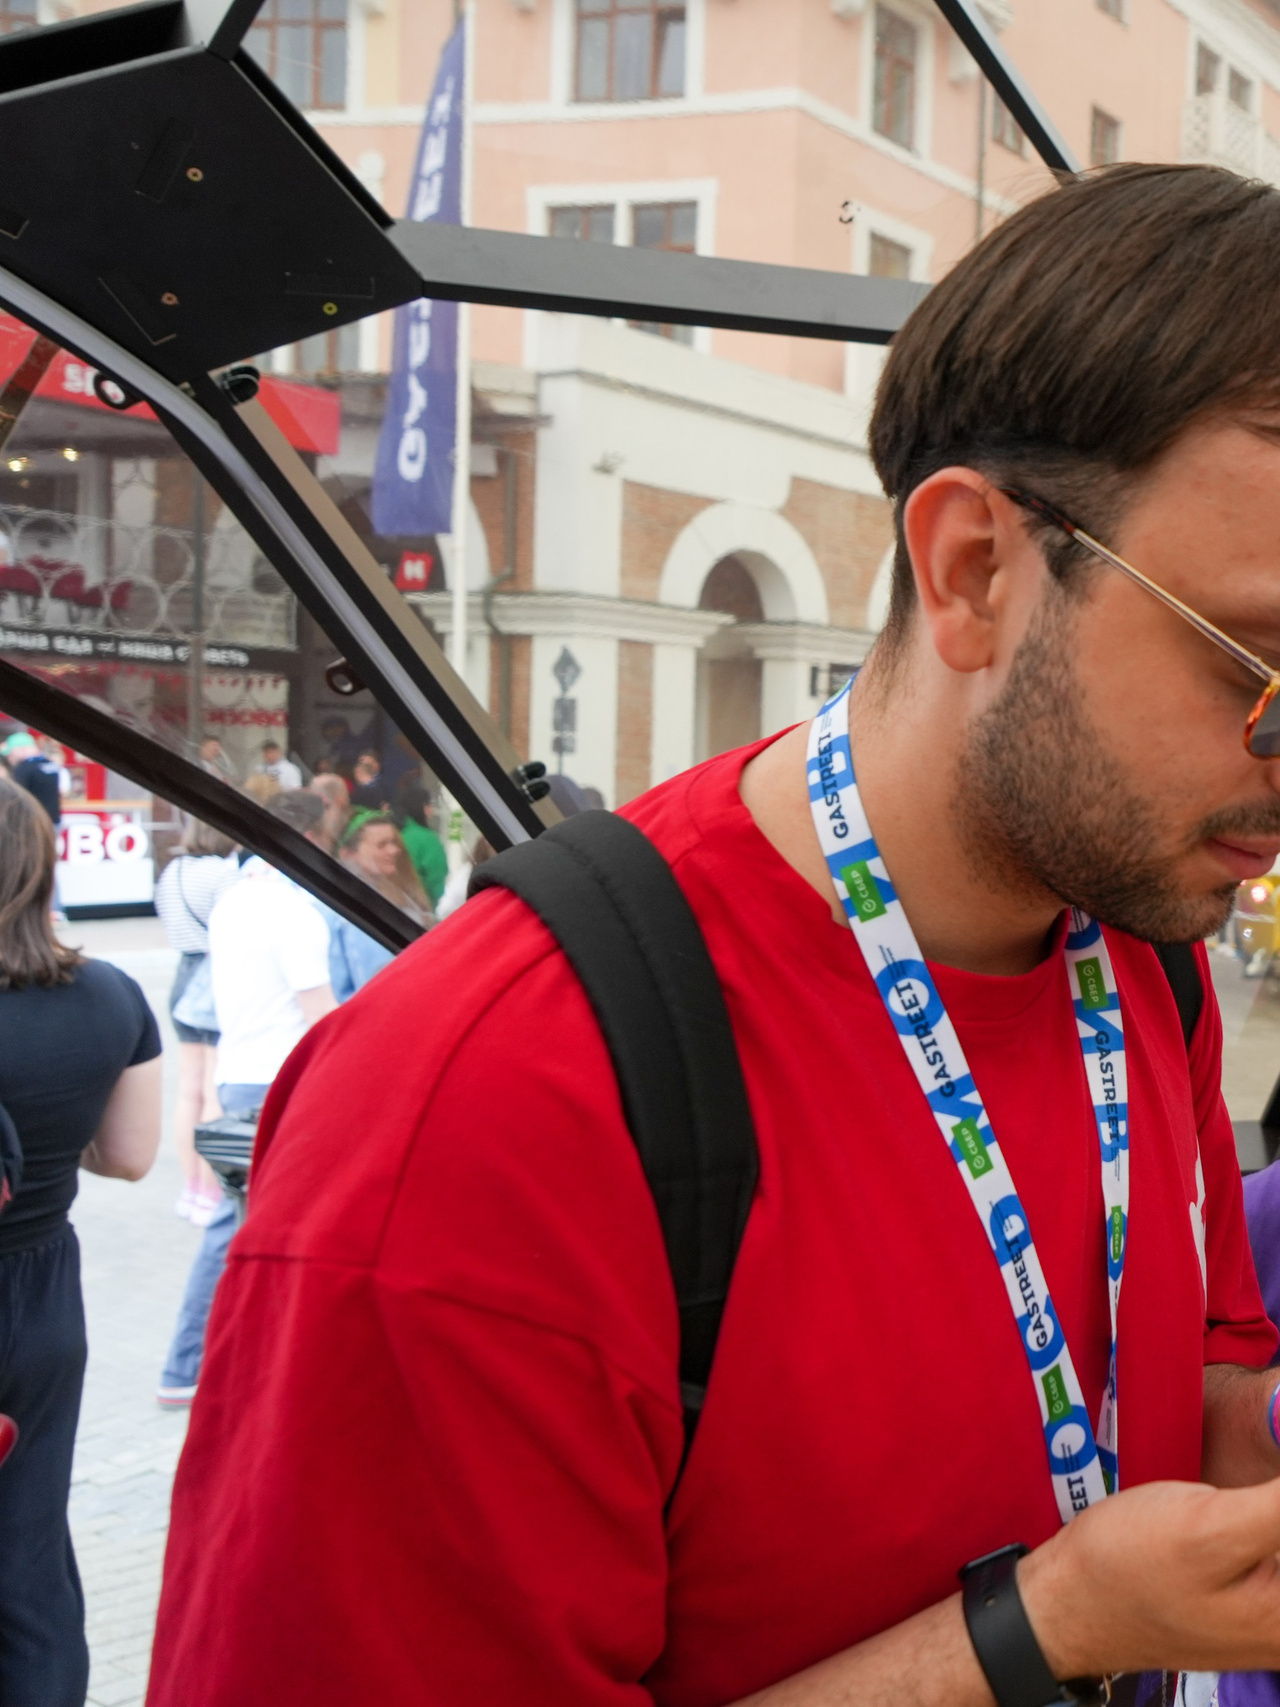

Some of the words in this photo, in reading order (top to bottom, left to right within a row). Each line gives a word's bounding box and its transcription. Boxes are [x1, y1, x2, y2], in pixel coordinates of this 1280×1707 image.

[397, 76, 455, 482] GASEET
[176, 646, 249, 667] свесть
[818, 732, 849, 839] GASTREET
[851, 870, 869, 898] СБЕР
[1087, 979, 1099, 1003] СБЕР
[894, 982, 956, 1098] GASTREET
[1094, 1030, 1120, 1142] GASTREET
[961, 1128, 978, 1155] СБЕР
[1004, 1234, 1048, 1348] GASTREET
[1049, 1375, 1059, 1400] СБЕР
[1067, 1475, 1089, 1516] EET
